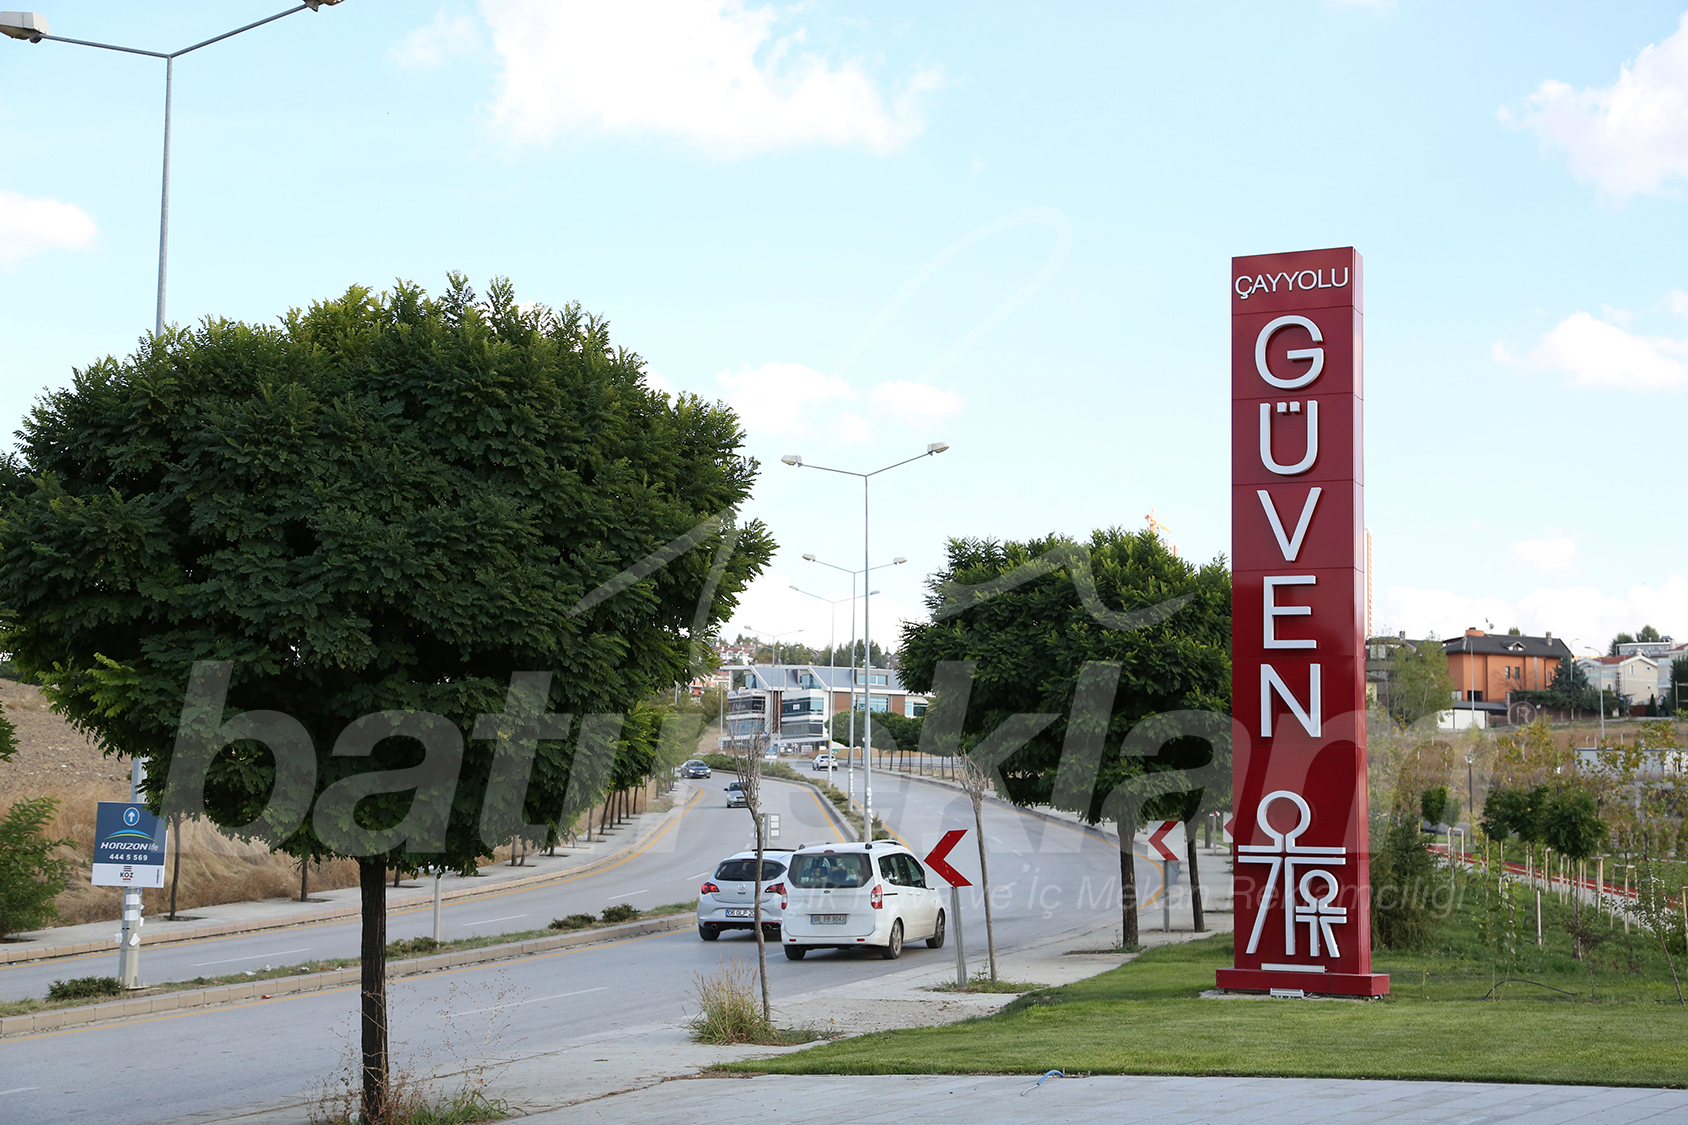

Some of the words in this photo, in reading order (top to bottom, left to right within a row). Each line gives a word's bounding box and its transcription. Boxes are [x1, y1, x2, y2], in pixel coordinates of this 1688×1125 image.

[1235, 267, 1349, 300] ÇAYYOLU
[1254, 314, 1326, 738] GÜVEN
[109, 853, 124, 861] 444
[133, 854, 148, 862] 569
